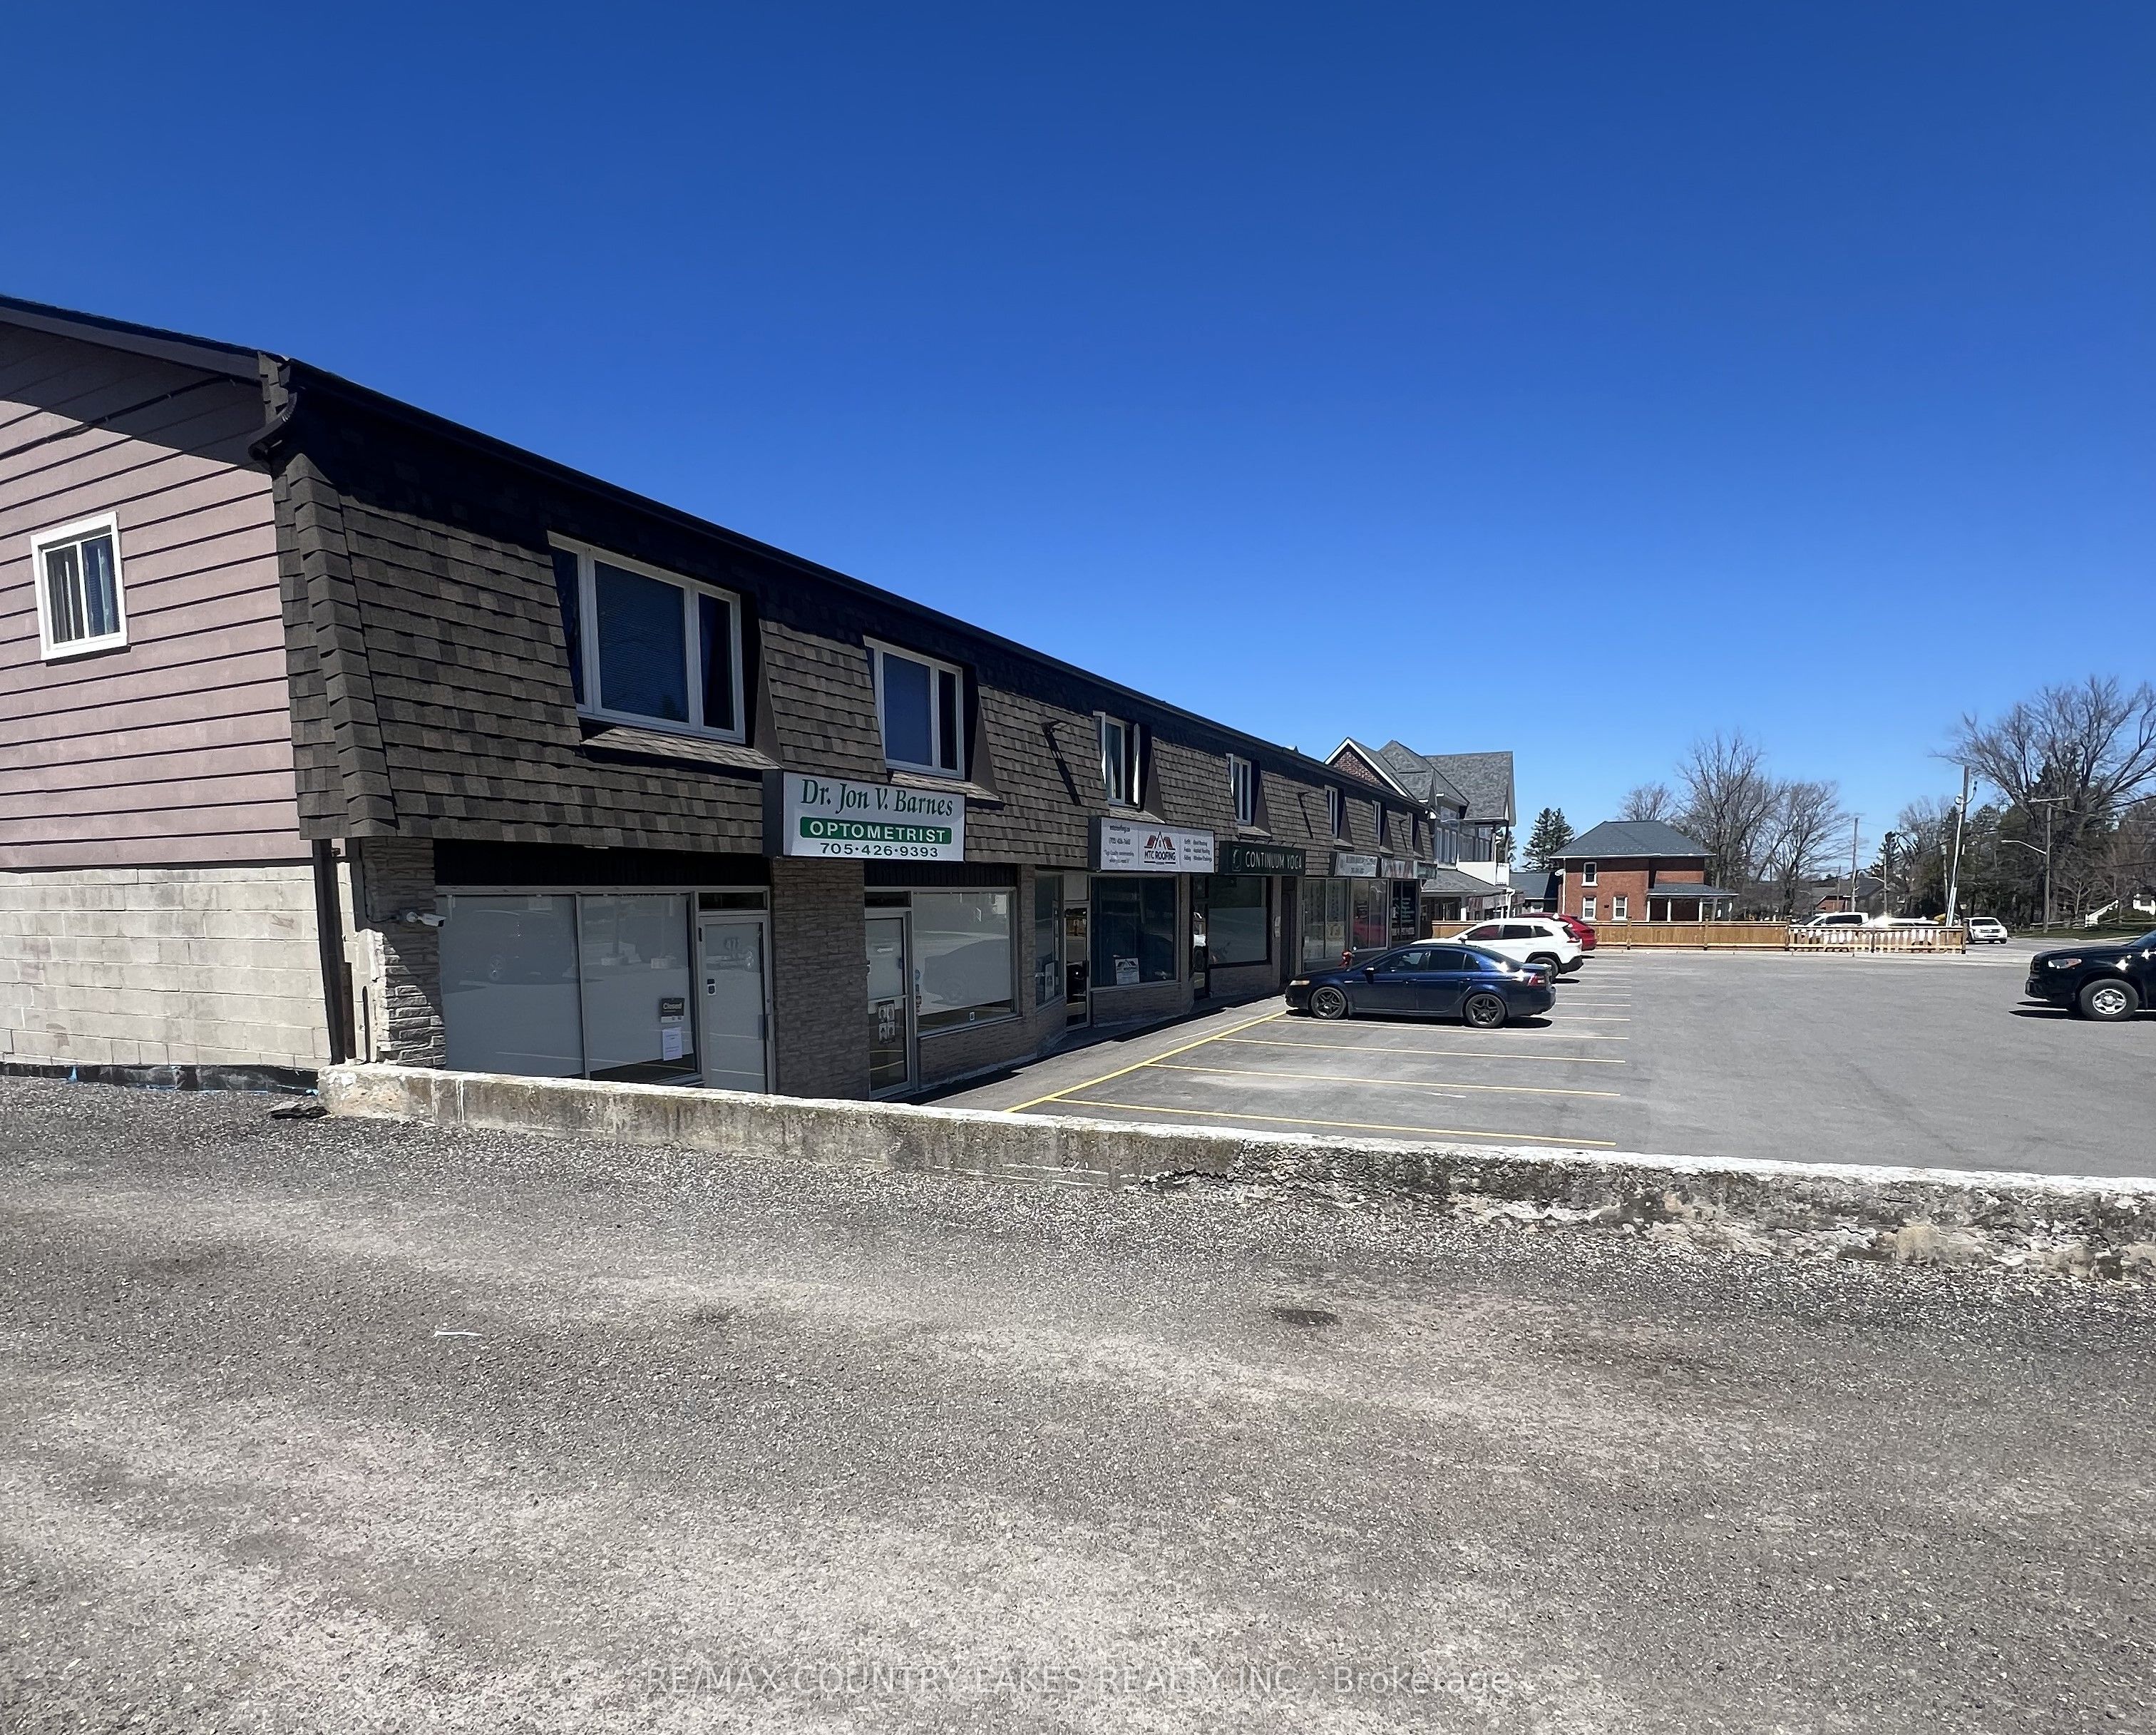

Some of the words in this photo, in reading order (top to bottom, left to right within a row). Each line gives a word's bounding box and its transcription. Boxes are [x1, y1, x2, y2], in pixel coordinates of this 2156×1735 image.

[801, 779, 831, 805] Dr.
[835, 783, 870, 814] Jon
[876, 787, 888, 810] V.
[894, 789, 953, 817] Barnes
[810, 821, 945, 842] OPTOMETRIST
[1155, 851, 1176, 861] ROOFING
[1246, 851, 1284, 869] CONTINUUM
[1286, 854, 1302, 869] YOGA
